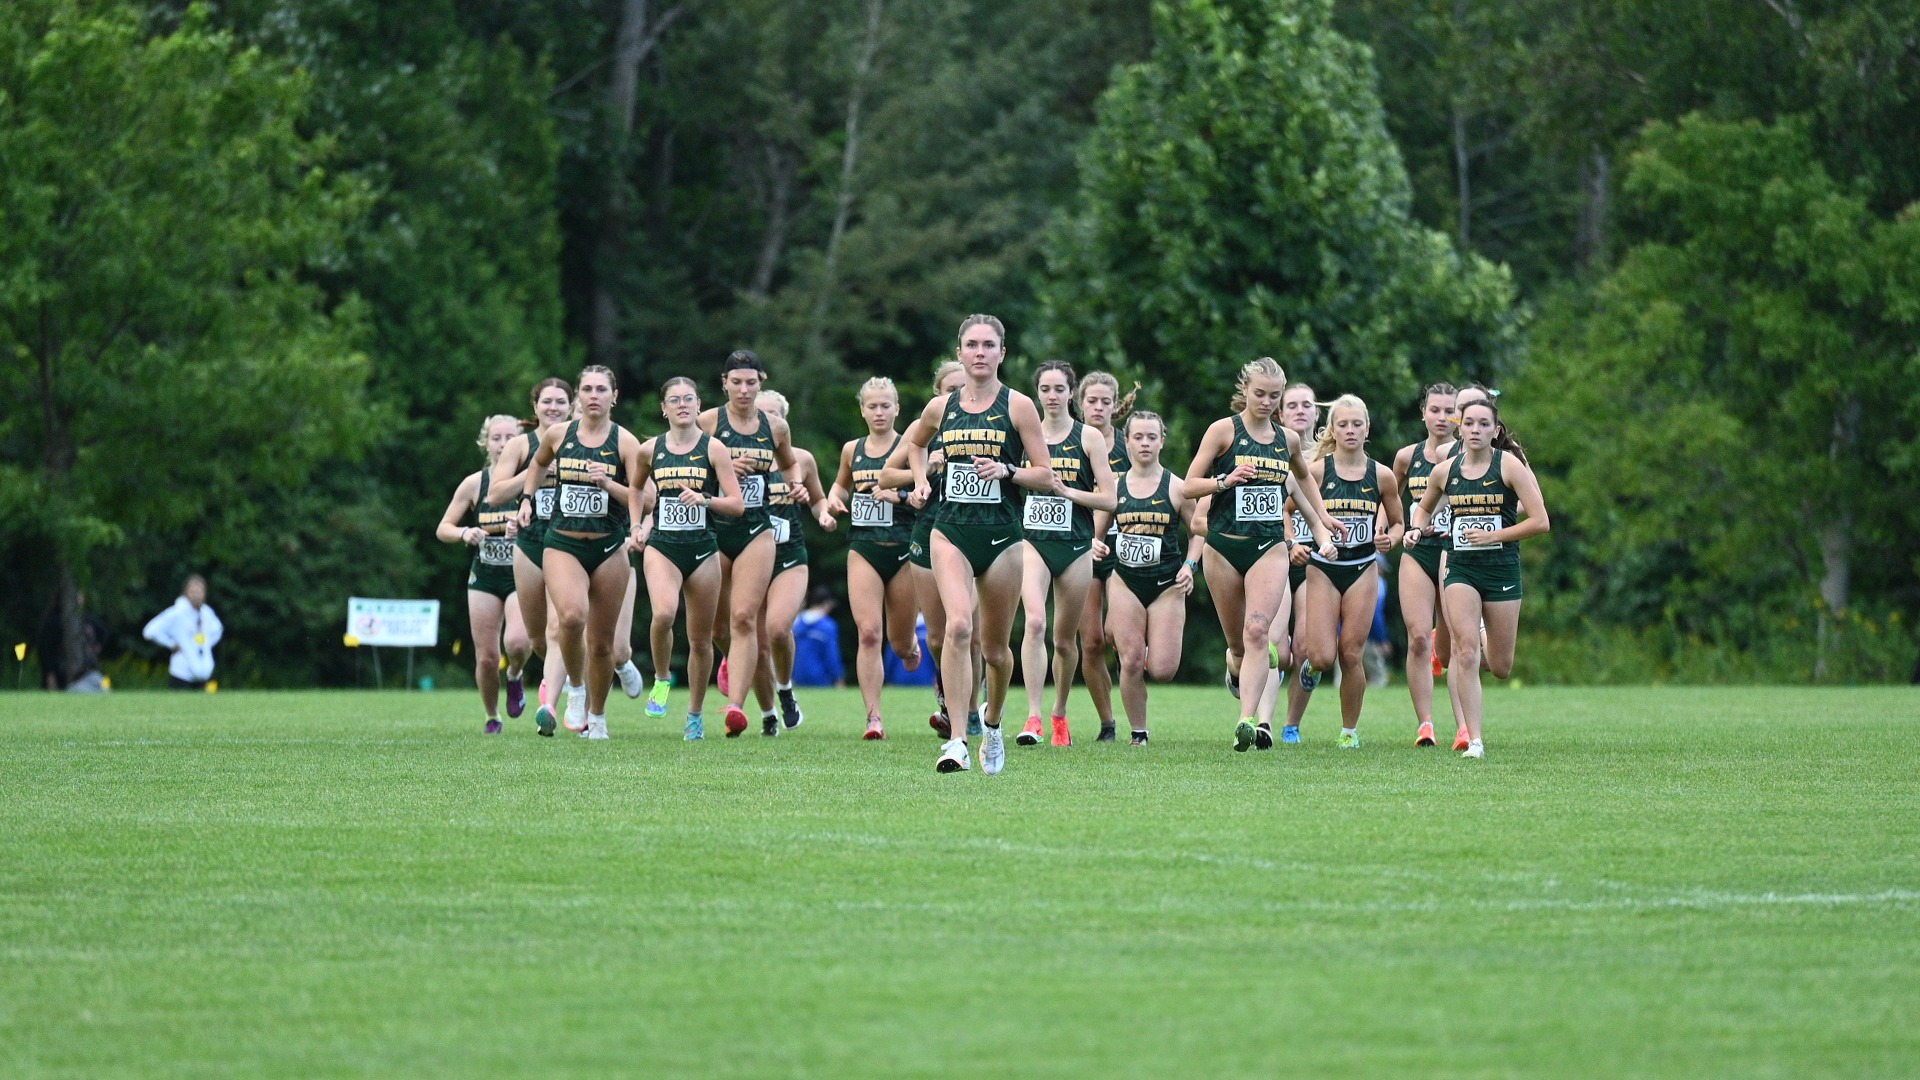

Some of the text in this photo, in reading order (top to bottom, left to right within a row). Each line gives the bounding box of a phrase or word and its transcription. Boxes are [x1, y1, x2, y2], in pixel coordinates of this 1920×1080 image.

[942, 429, 1006, 443] NORTHERN
[946, 444, 1001, 457] MICHIGAN
[654, 467, 707, 479] NORTHERN
[952, 471, 993, 496] 387
[565, 491, 602, 513] 376
[853, 500, 884, 520] 371
[1242, 493, 1278, 515] 369
[1449, 494, 1504, 505] NORTHERN
[664, 503, 700, 525] 380
[1029, 502, 1066, 524] 388
[1117, 512, 1170, 524] NORTHERN
[1120, 540, 1155, 562] 379
